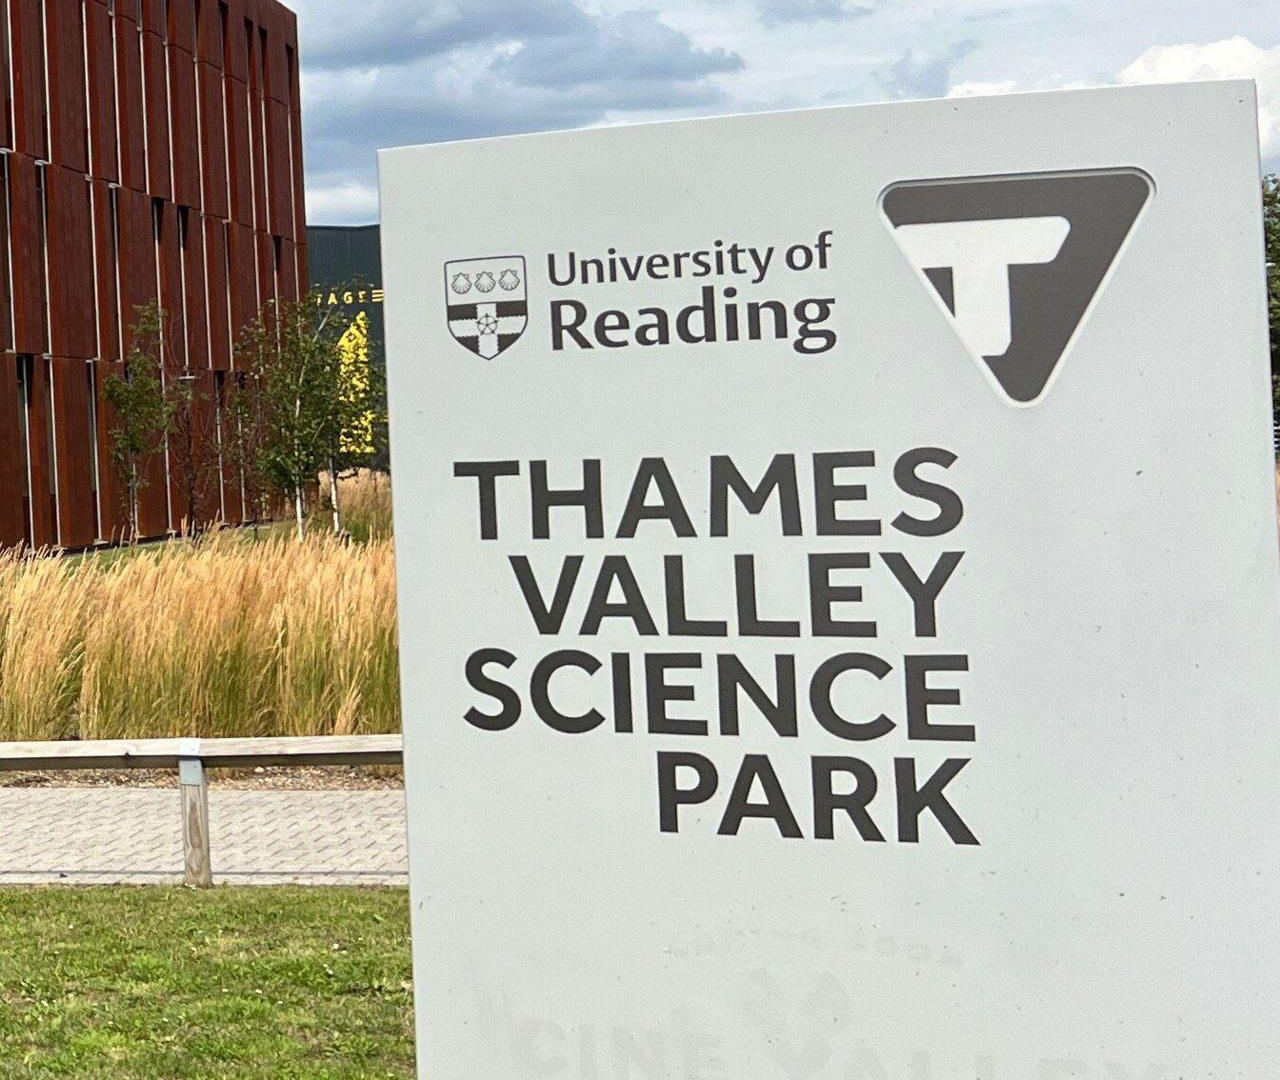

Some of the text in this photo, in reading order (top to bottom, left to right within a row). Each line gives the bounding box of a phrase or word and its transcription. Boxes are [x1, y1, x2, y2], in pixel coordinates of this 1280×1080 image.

[546, 230, 834, 288] University of
[550, 286, 838, 356] Reading
[453, 447, 965, 541] THAMES
[507, 550, 966, 639] VALLEY
[463, 647, 977, 742] SCIENCE
[656, 750, 981, 846] PARK
